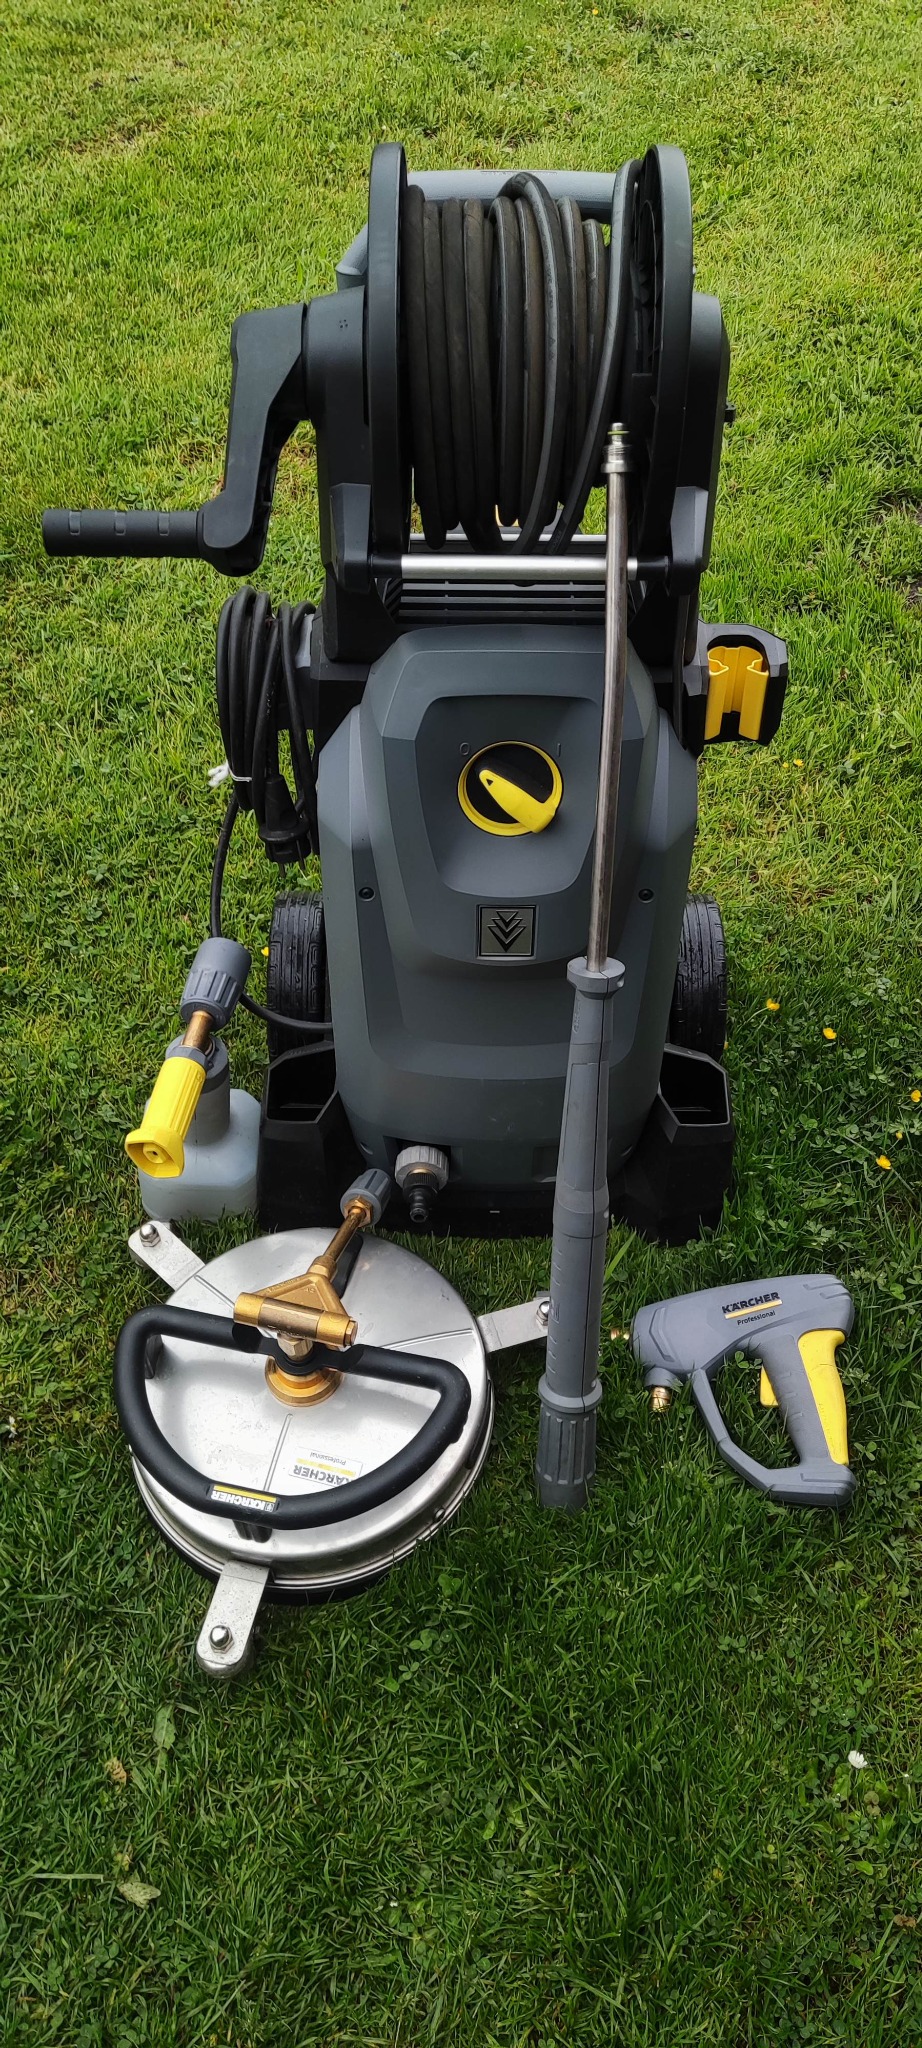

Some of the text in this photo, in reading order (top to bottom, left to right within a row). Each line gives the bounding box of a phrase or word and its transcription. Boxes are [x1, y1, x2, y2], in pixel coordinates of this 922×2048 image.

[721, 1291, 780, 1314] KÄRCHER
[737, 1310, 776, 1326] Professional
[310, 1452, 347, 1466] Professional
